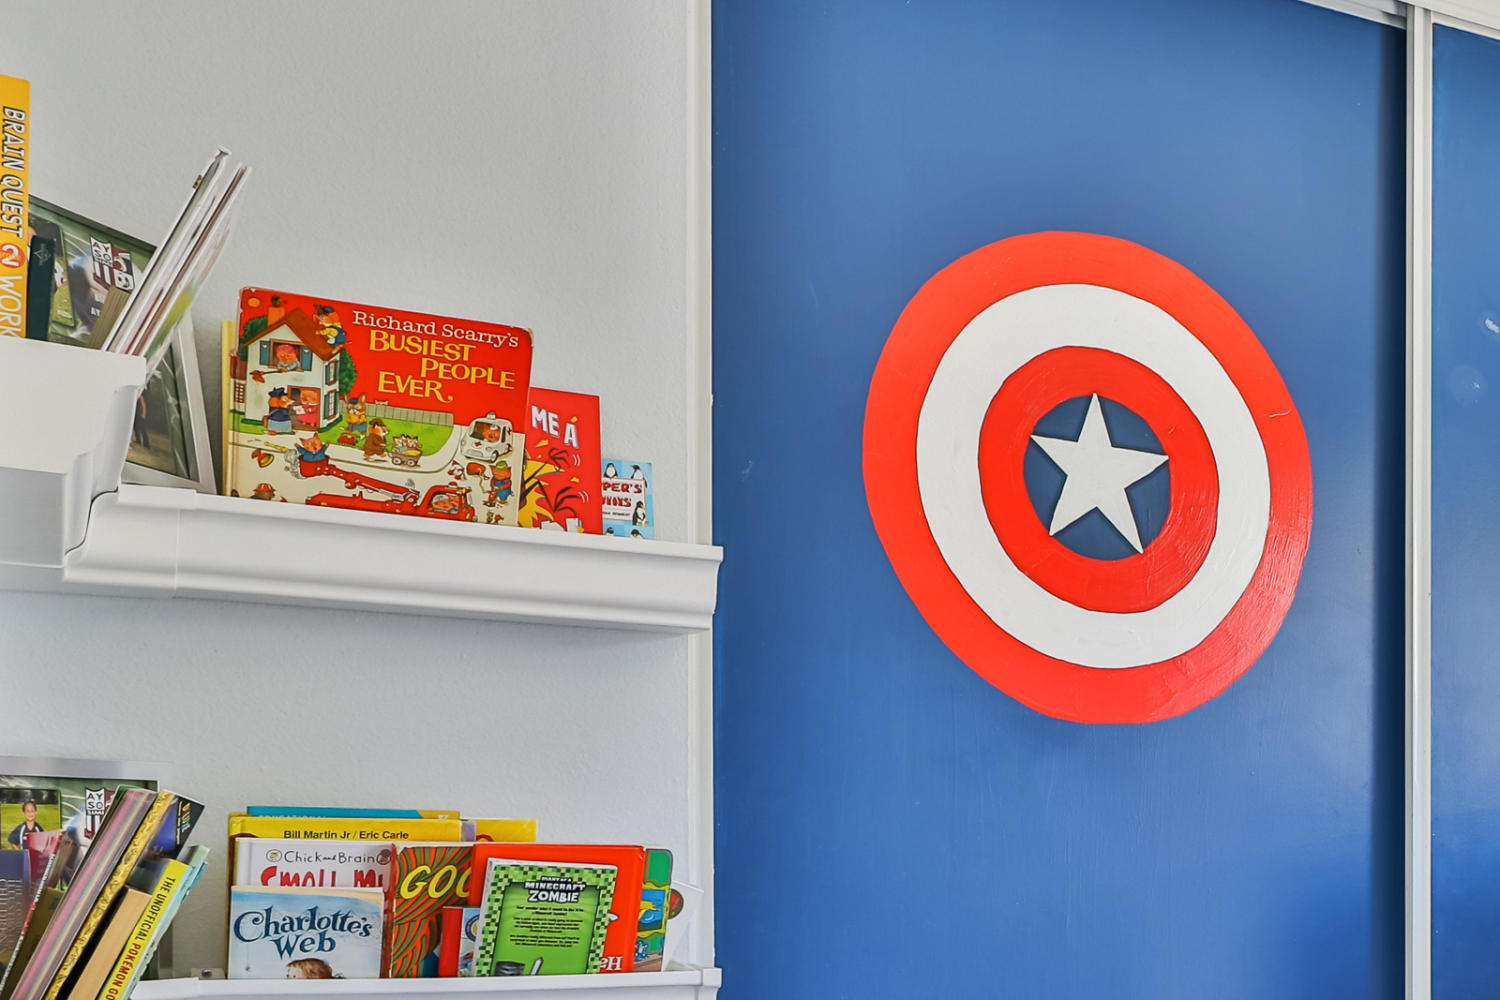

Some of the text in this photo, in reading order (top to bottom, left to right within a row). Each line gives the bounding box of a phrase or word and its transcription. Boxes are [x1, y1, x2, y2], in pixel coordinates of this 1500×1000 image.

[0, 106, 26, 240] BRAIN QUEST
[352, 310, 519, 348] Richard Scarry's
[369, 329, 476, 361] BUSIEST
[420, 357, 515, 390] PEOPLE
[531, 405, 579, 449] ME A
[283, 830, 300, 839] Bill
[303, 830, 337, 839] Martin
[340, 830, 351, 839] Jr
[359, 830, 379, 839] Eric
[382, 830, 409, 839] Carle
[284, 850, 322, 863] Chick
[338, 851, 375, 864] Brain
[160, 876, 177, 893] THE
[525, 881, 586, 891] MINECRAFT
[528, 890, 579, 903] ZOMBIE
[135, 893, 167, 941] UNOFFICIAL
[233, 905, 373, 943] Charlotte's
[269, 930, 336, 960] Web
[105, 986, 120, 1000] GO
